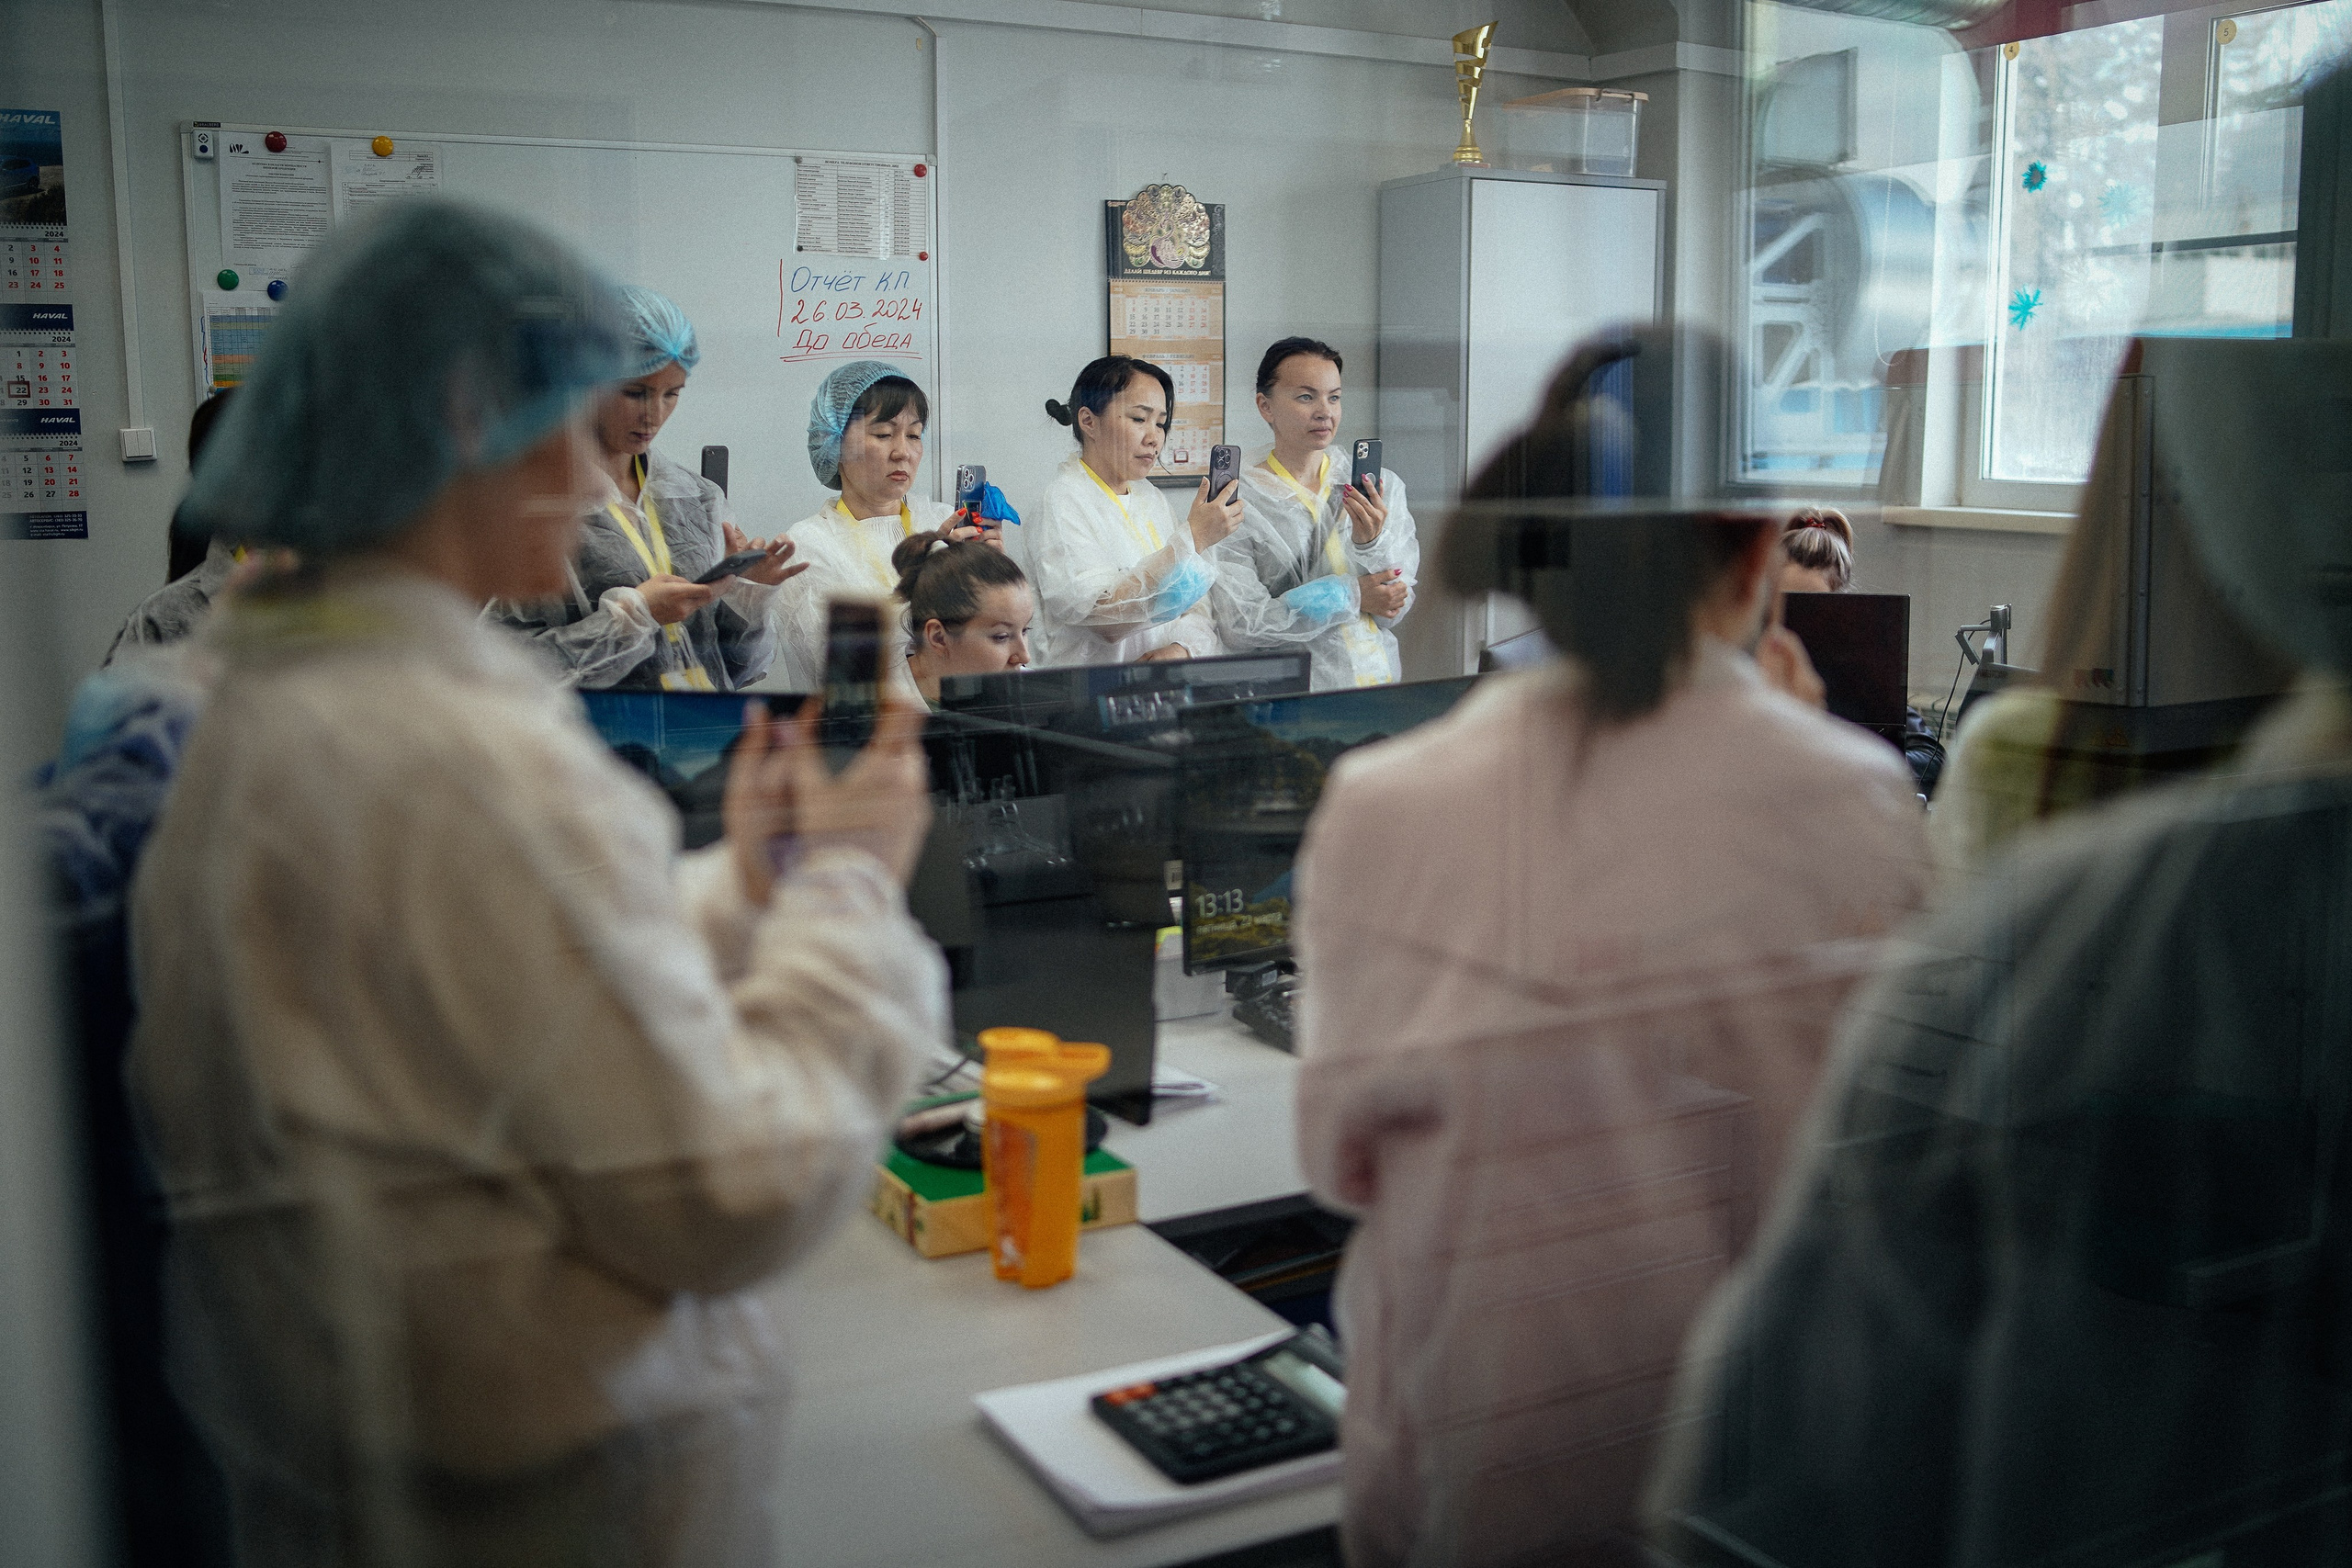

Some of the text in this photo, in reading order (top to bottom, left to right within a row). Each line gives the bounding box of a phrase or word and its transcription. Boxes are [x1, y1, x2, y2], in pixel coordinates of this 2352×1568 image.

[0, 114, 55, 124] HAVAL
[791, 266, 865, 293] Отчёт
[1194, 888, 1244, 919] 13:13
